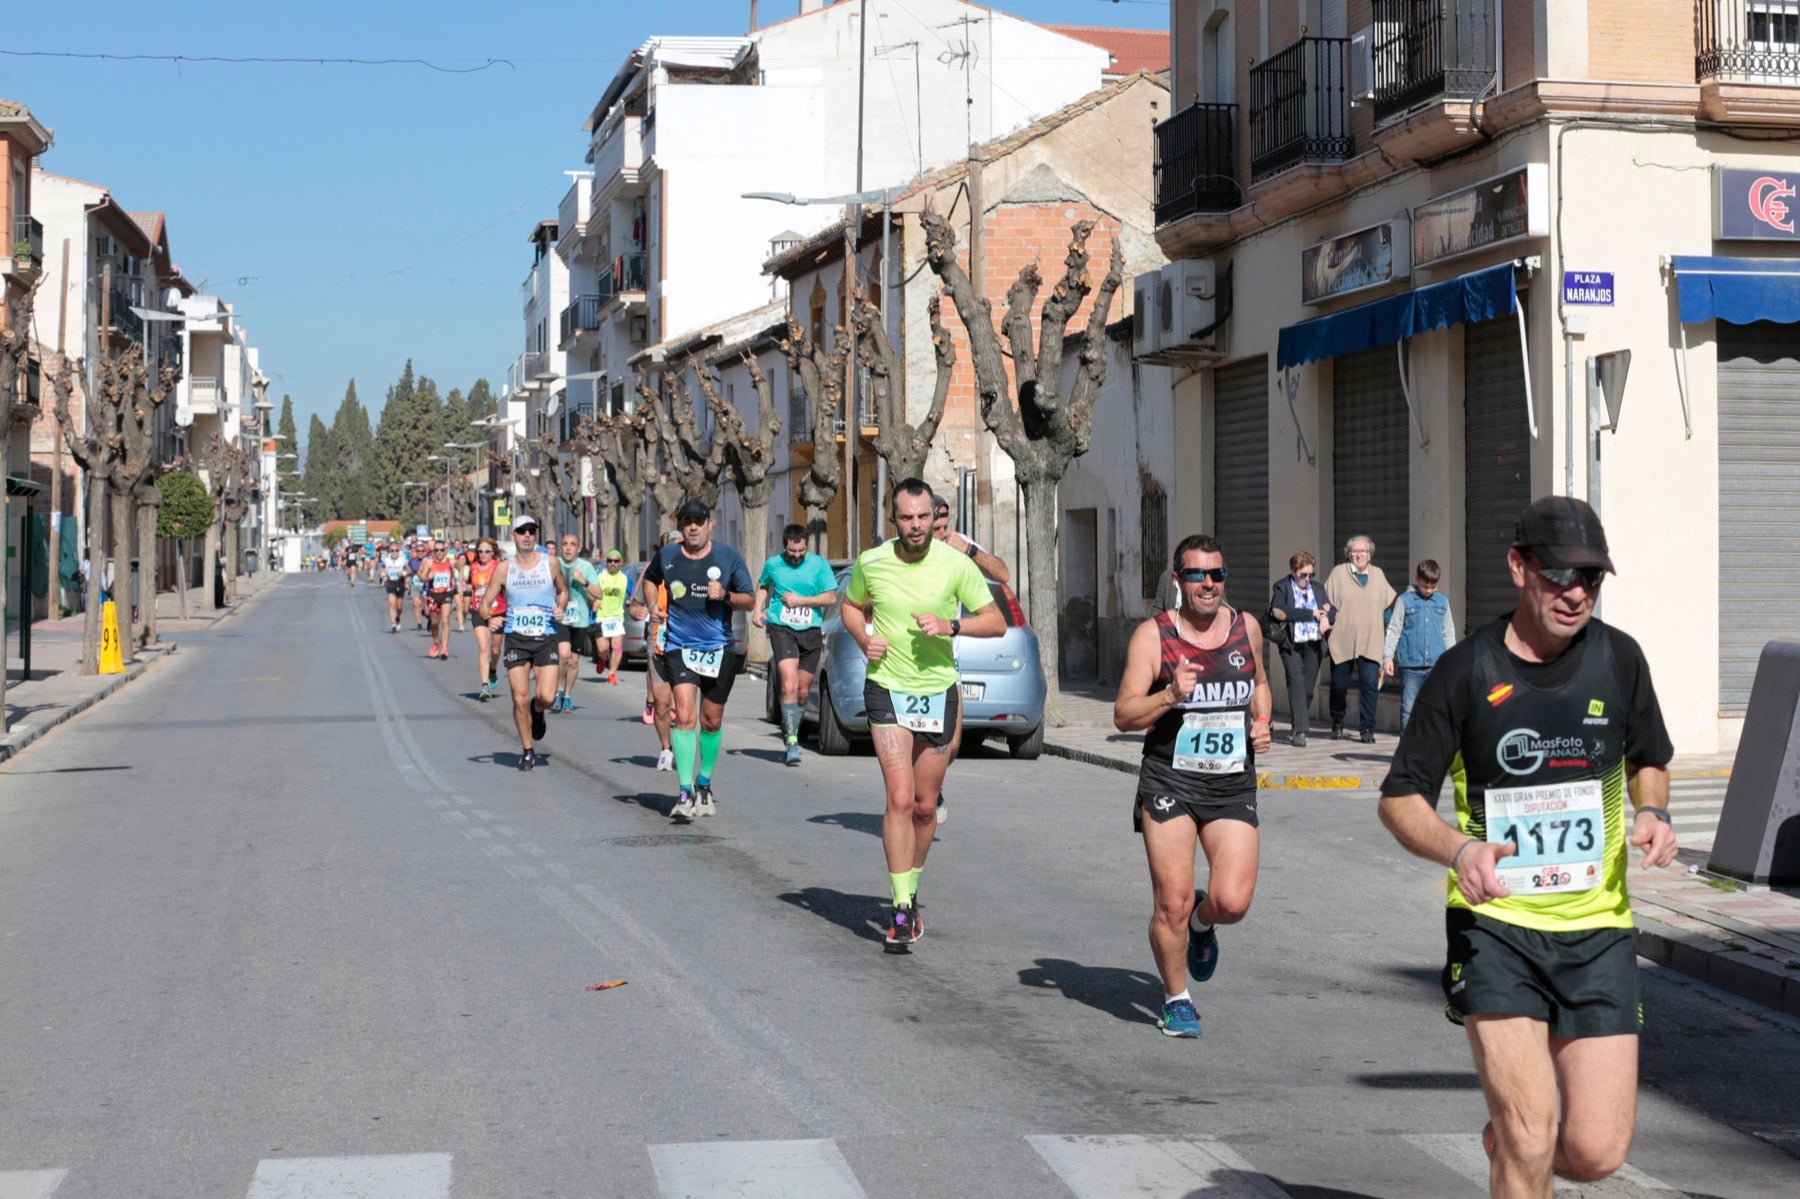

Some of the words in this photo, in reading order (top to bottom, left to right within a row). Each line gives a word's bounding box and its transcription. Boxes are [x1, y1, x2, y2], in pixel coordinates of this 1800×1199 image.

[1574, 274, 1601, 284] PLAZA
[1567, 288, 1611, 302] NARANJOS
[516, 615, 544, 627] 1042
[103, 628, 110, 651] 9
[689, 649, 715, 665] 573
[906, 695, 930, 714] 23
[1190, 732, 1234, 755] 158
[1530, 736, 1583, 750] MasFoto
[1513, 791, 1534, 802] GRAN
[1535, 788, 1562, 801] PREMIO
[1564, 787, 1573, 799] DE
[1503, 817, 1595, 857] 1173
